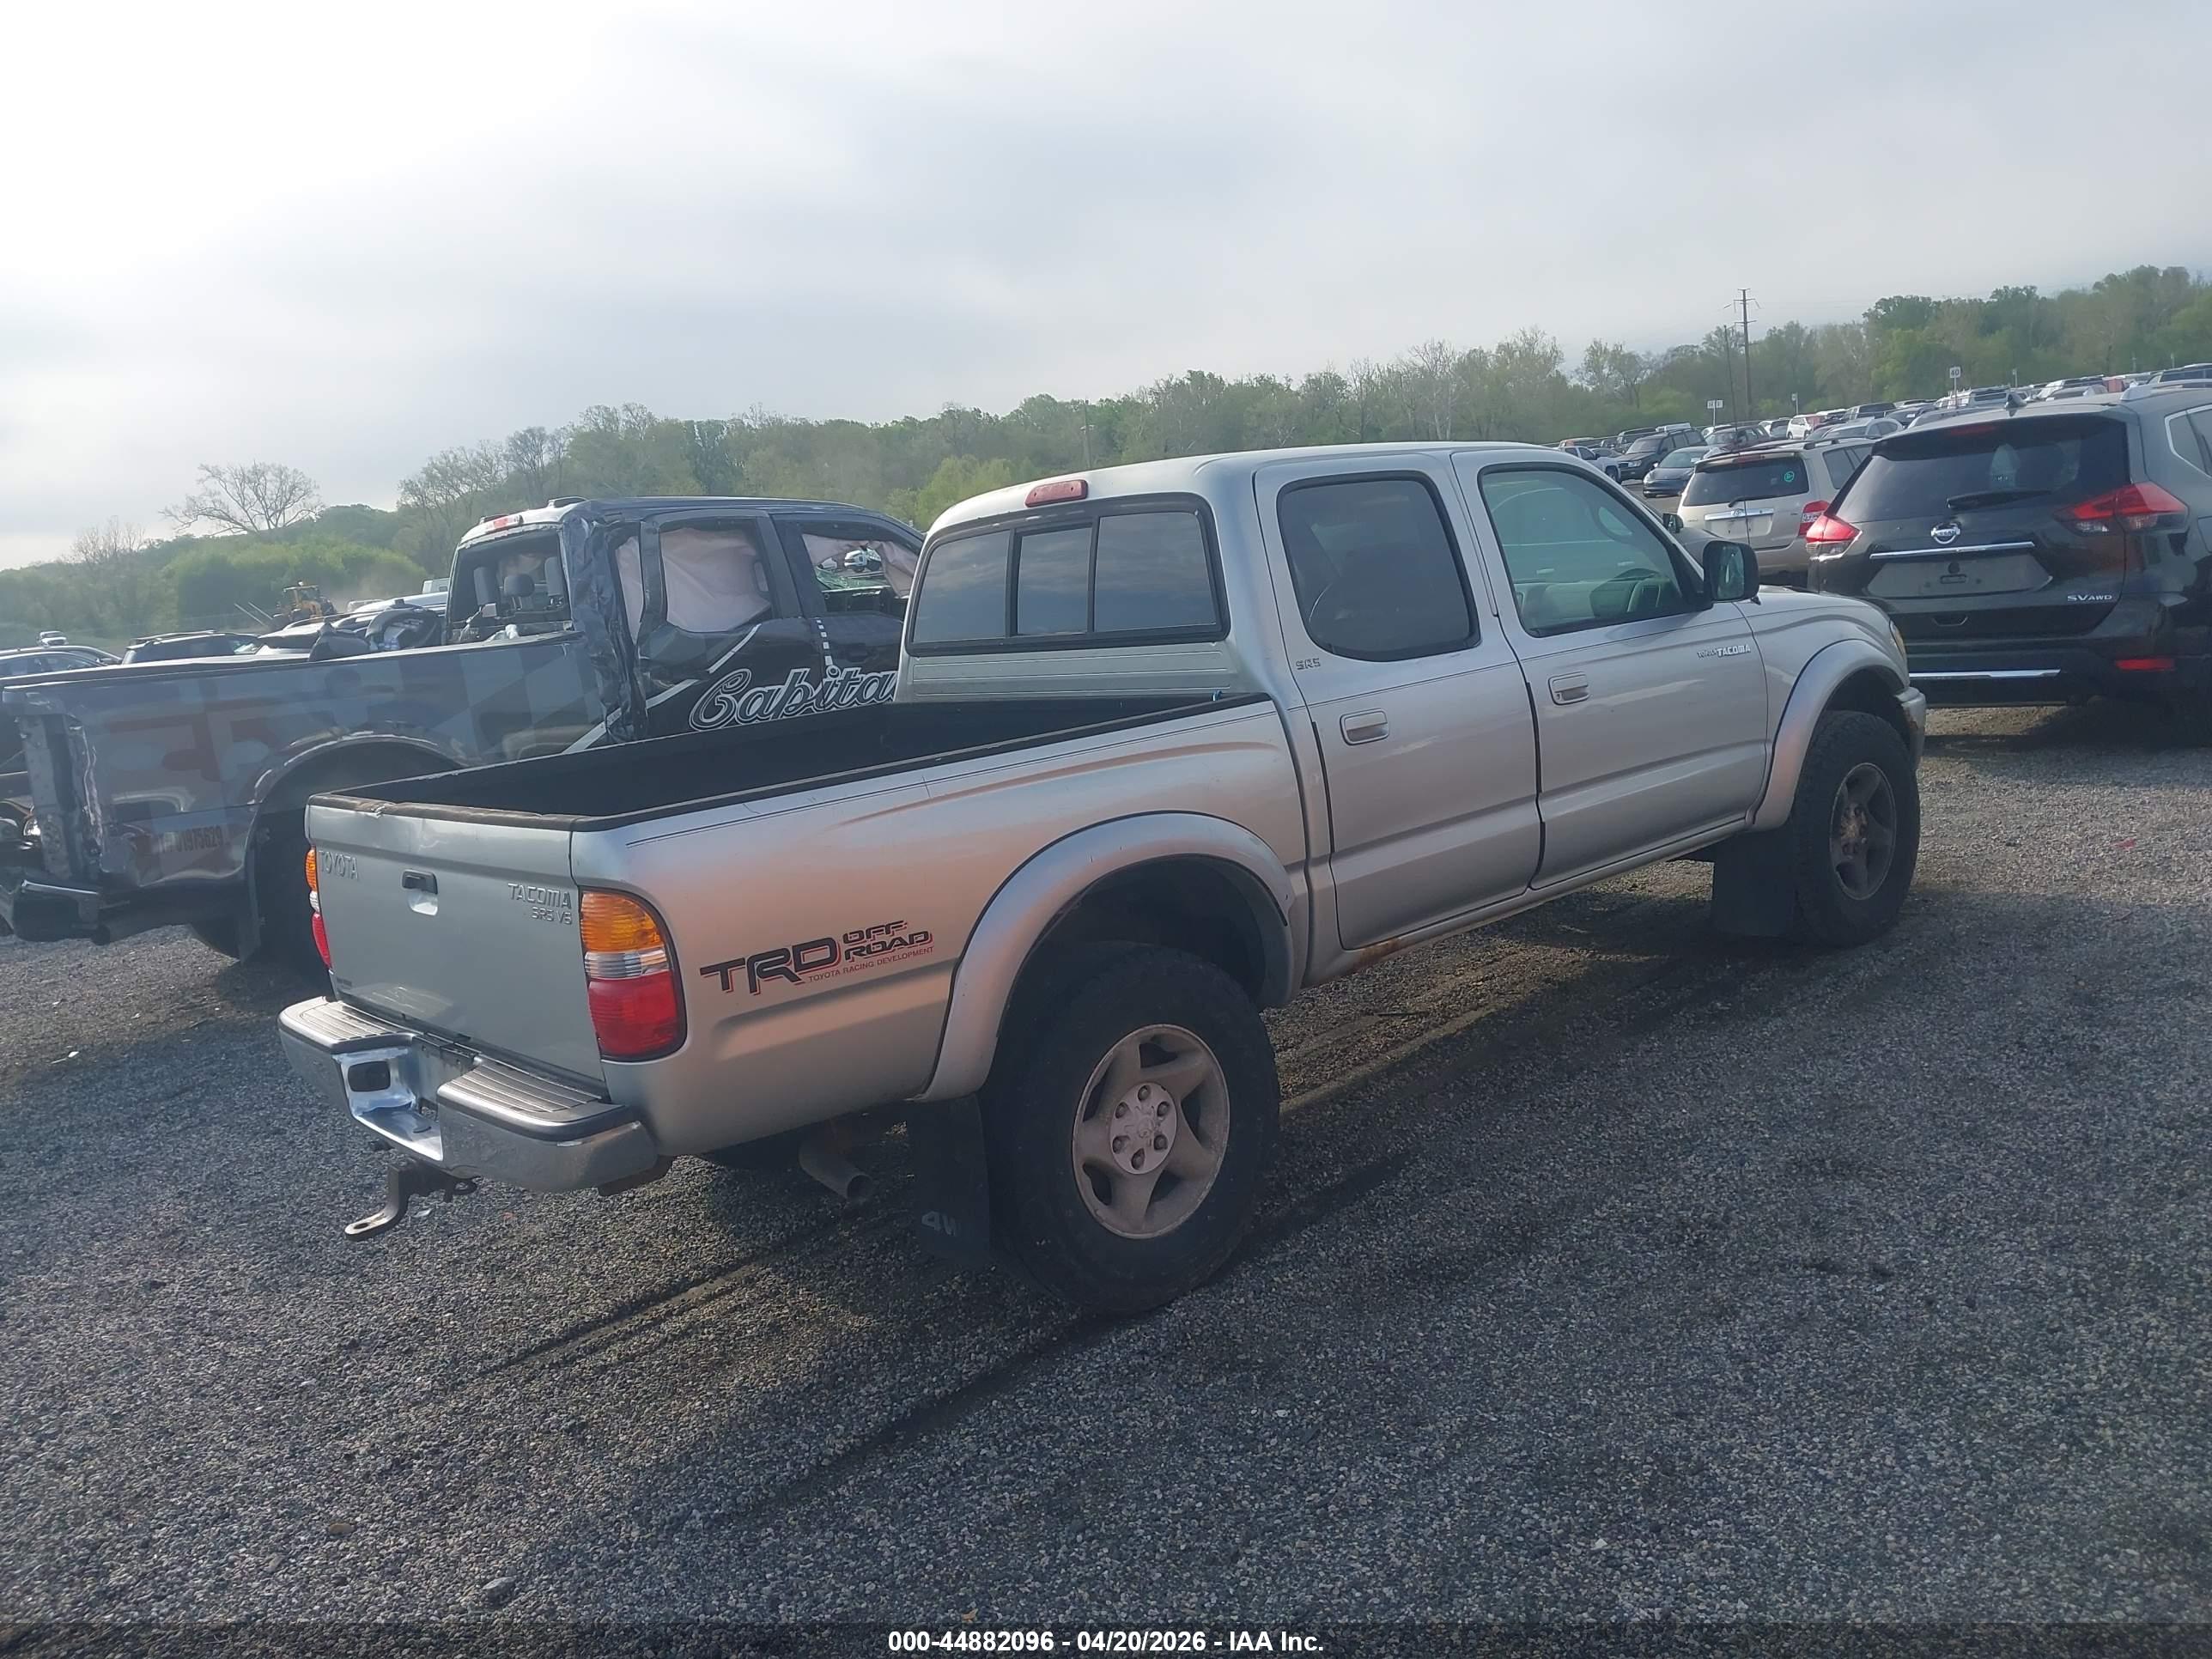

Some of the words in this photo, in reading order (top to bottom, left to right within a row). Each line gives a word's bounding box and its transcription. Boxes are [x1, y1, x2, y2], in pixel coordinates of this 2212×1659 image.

[1717, 644, 1751, 658] TACOMA
[689, 665, 898, 731] Capita
[319, 850, 359, 881] TOYOTA
[507, 883, 572, 909] TACOMA
[532, 906, 554, 921] SR5
[556, 910, 573, 925] V6
[842, 920, 908, 946] OFF
[844, 930, 933, 963] ROAD
[700, 937, 842, 995] TRD
[808, 969, 841, 983] TOYOTA
[842, 960, 874, 975] RACING
[877, 946, 934, 966] DEVELOPMENT
